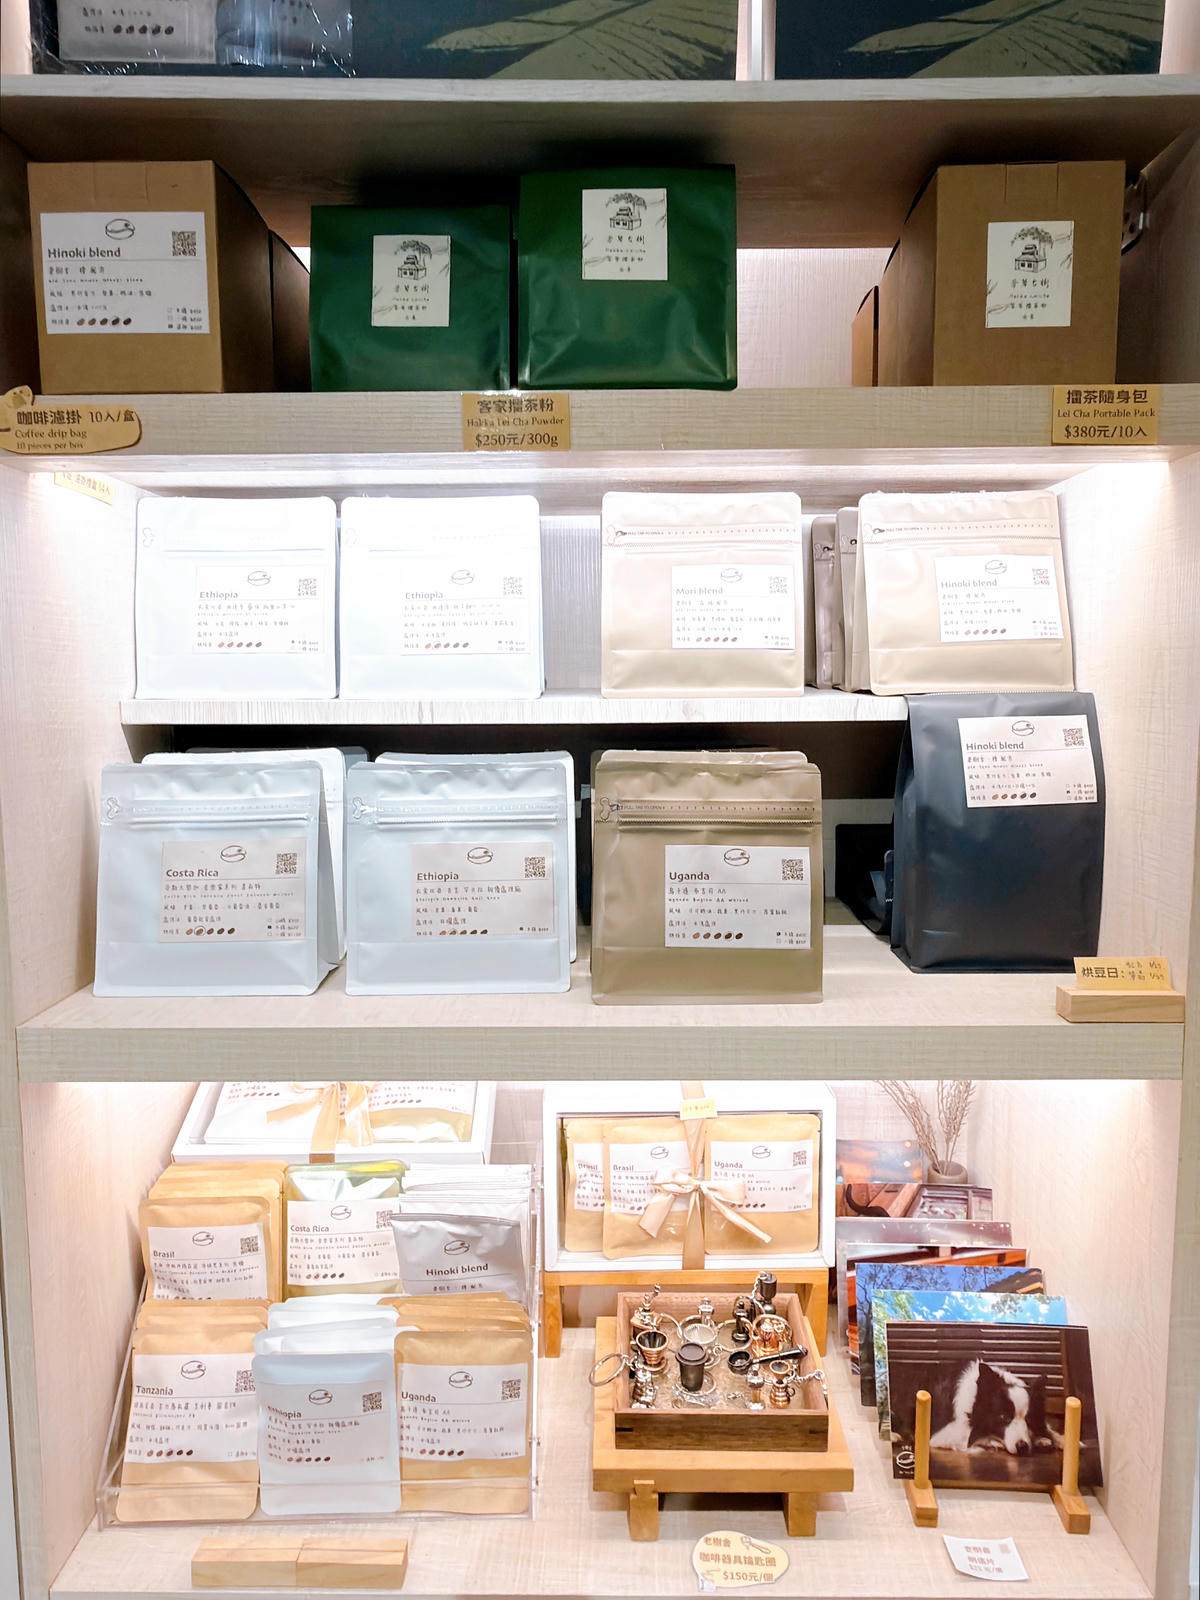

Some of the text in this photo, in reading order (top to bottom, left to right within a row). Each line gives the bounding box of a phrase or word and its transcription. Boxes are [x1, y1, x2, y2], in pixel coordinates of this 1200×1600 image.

[48, 247, 121, 259] Hinoki blend
[1066, 389, 1148, 404] 擂茶隨身包
[477, 398, 554, 413] 客家擂茶粉
[17, 409, 82, 425] 咖啡濾掛
[1057, 408, 1155, 418] Lei Cha Portable Pack
[467, 418, 494, 427] Hakka
[512, 417, 529, 426] Cha
[531, 416, 564, 425] Powder
[15, 428, 87, 439] Coffee drip bag
[1065, 424, 1147, 439] $380元/10入
[475, 432, 558, 448] $250元/300g
[941, 578, 998, 589] Hinoki blend
[199, 591, 239, 600] Ethiopia
[405, 592, 444, 601] Ethiopia
[699, 587, 723, 595] blend
[966, 741, 1025, 751] Hinoki blend
[166, 868, 219, 878] Costa Rica
[416, 871, 459, 882] Ethiopia
[669, 871, 710, 882] Uganda
[613, 1164, 635, 1172] Brasil
[714, 1160, 744, 1170] Uganda
[290, 1225, 330, 1233] Costa Rica
[153, 1250, 175, 1258] Brasil
[426, 1263, 489, 1277] Hinoki blend
[136, 1385, 174, 1396] Tanzania
[401, 1391, 437, 1403] Uganda
